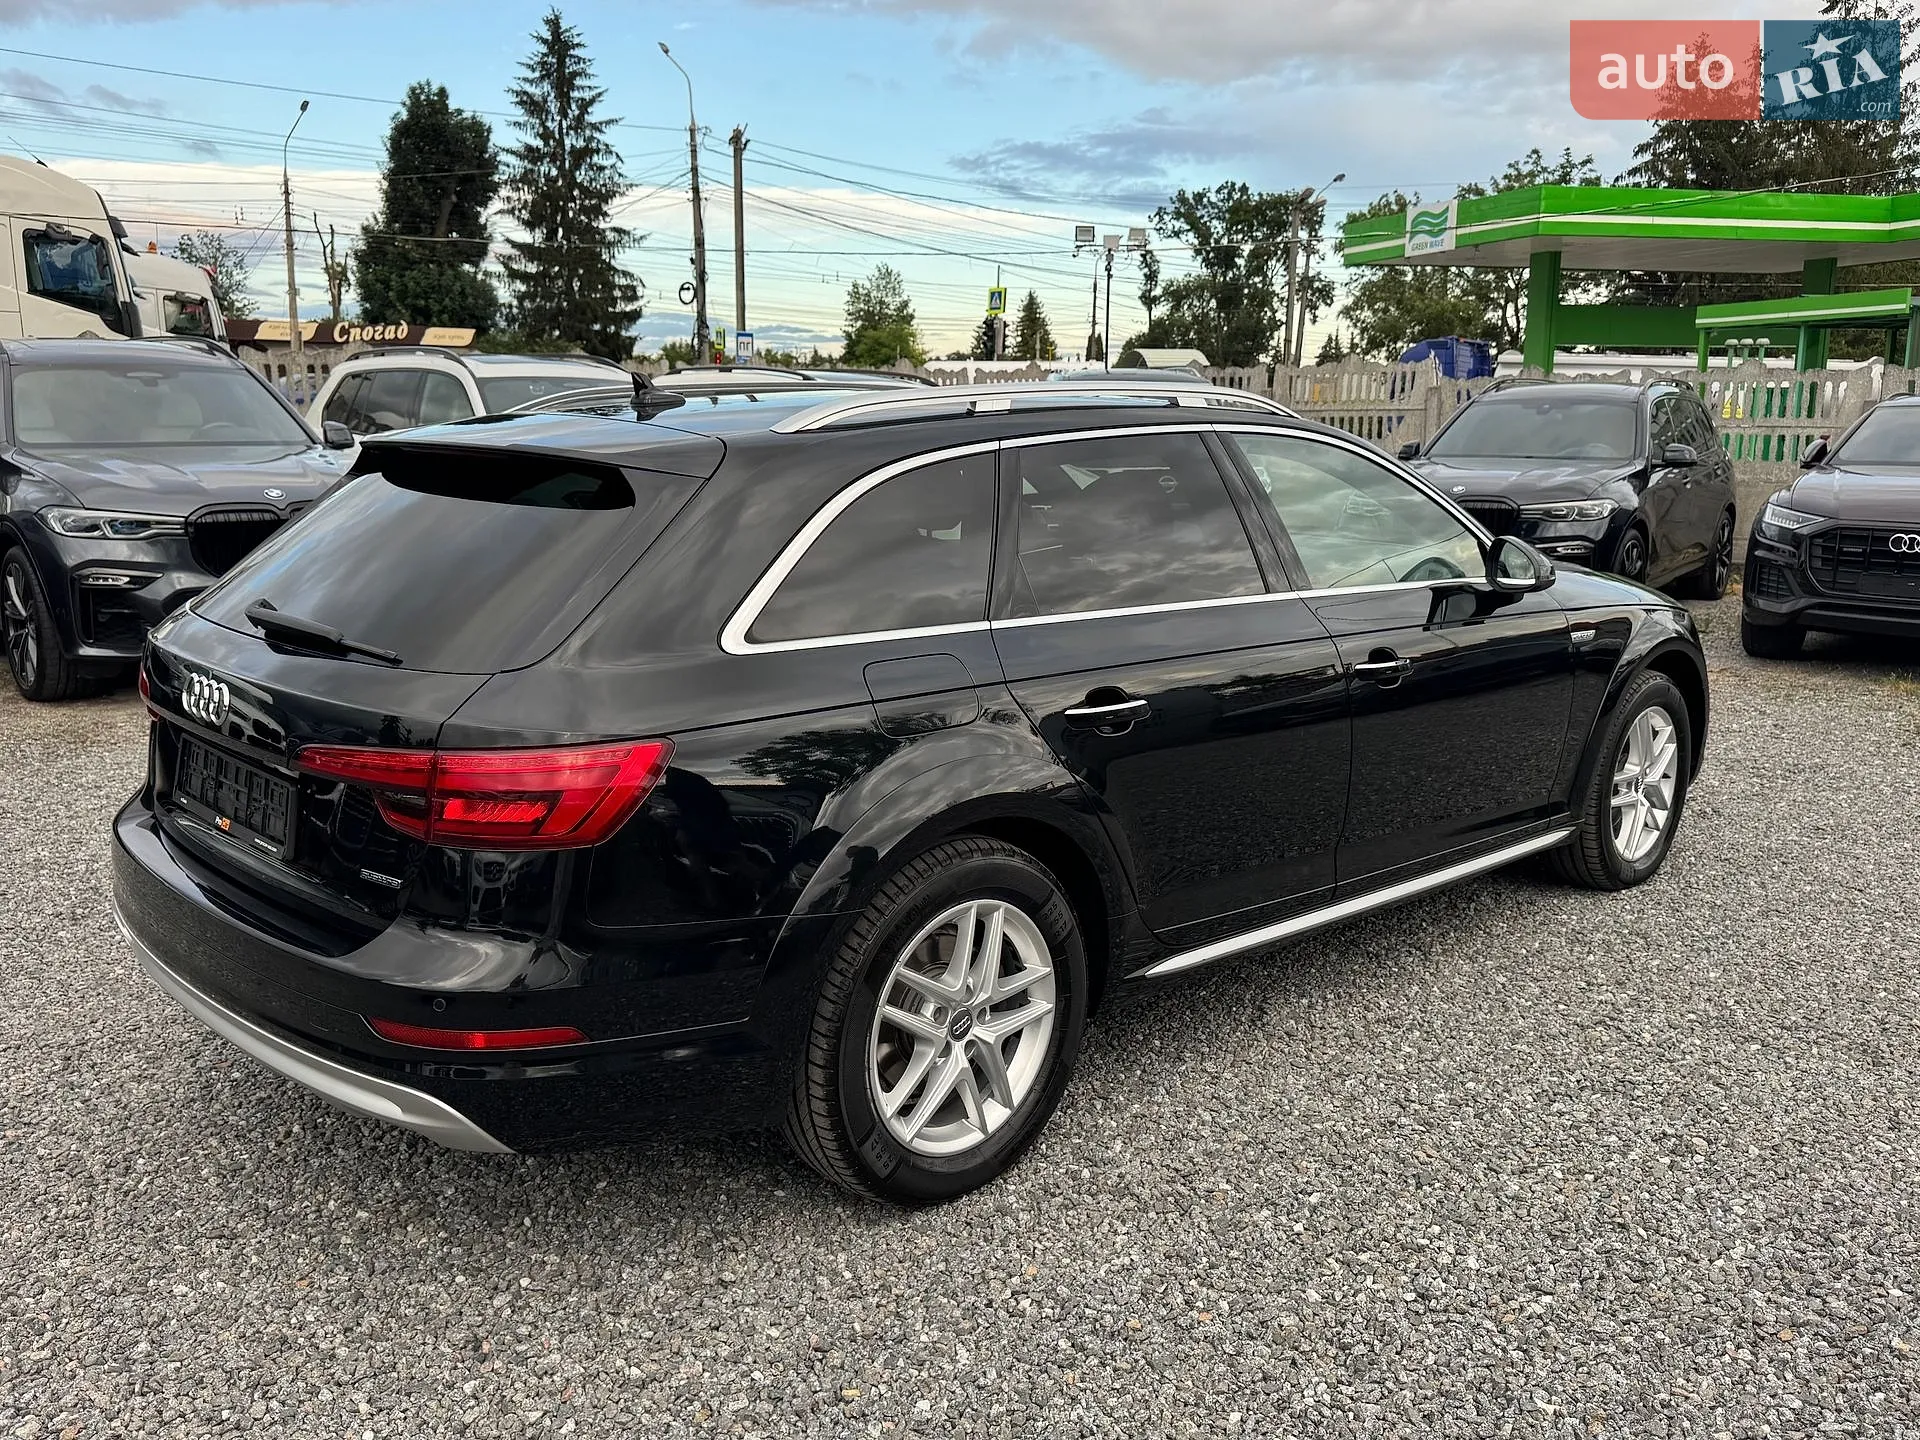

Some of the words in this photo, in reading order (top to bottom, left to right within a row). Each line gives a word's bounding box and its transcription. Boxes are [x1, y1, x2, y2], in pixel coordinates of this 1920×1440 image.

[1411, 242, 1428, 251] GREEN
[1429, 239, 1444, 248] WAVE
[333, 319, 409, 343] Спогад
